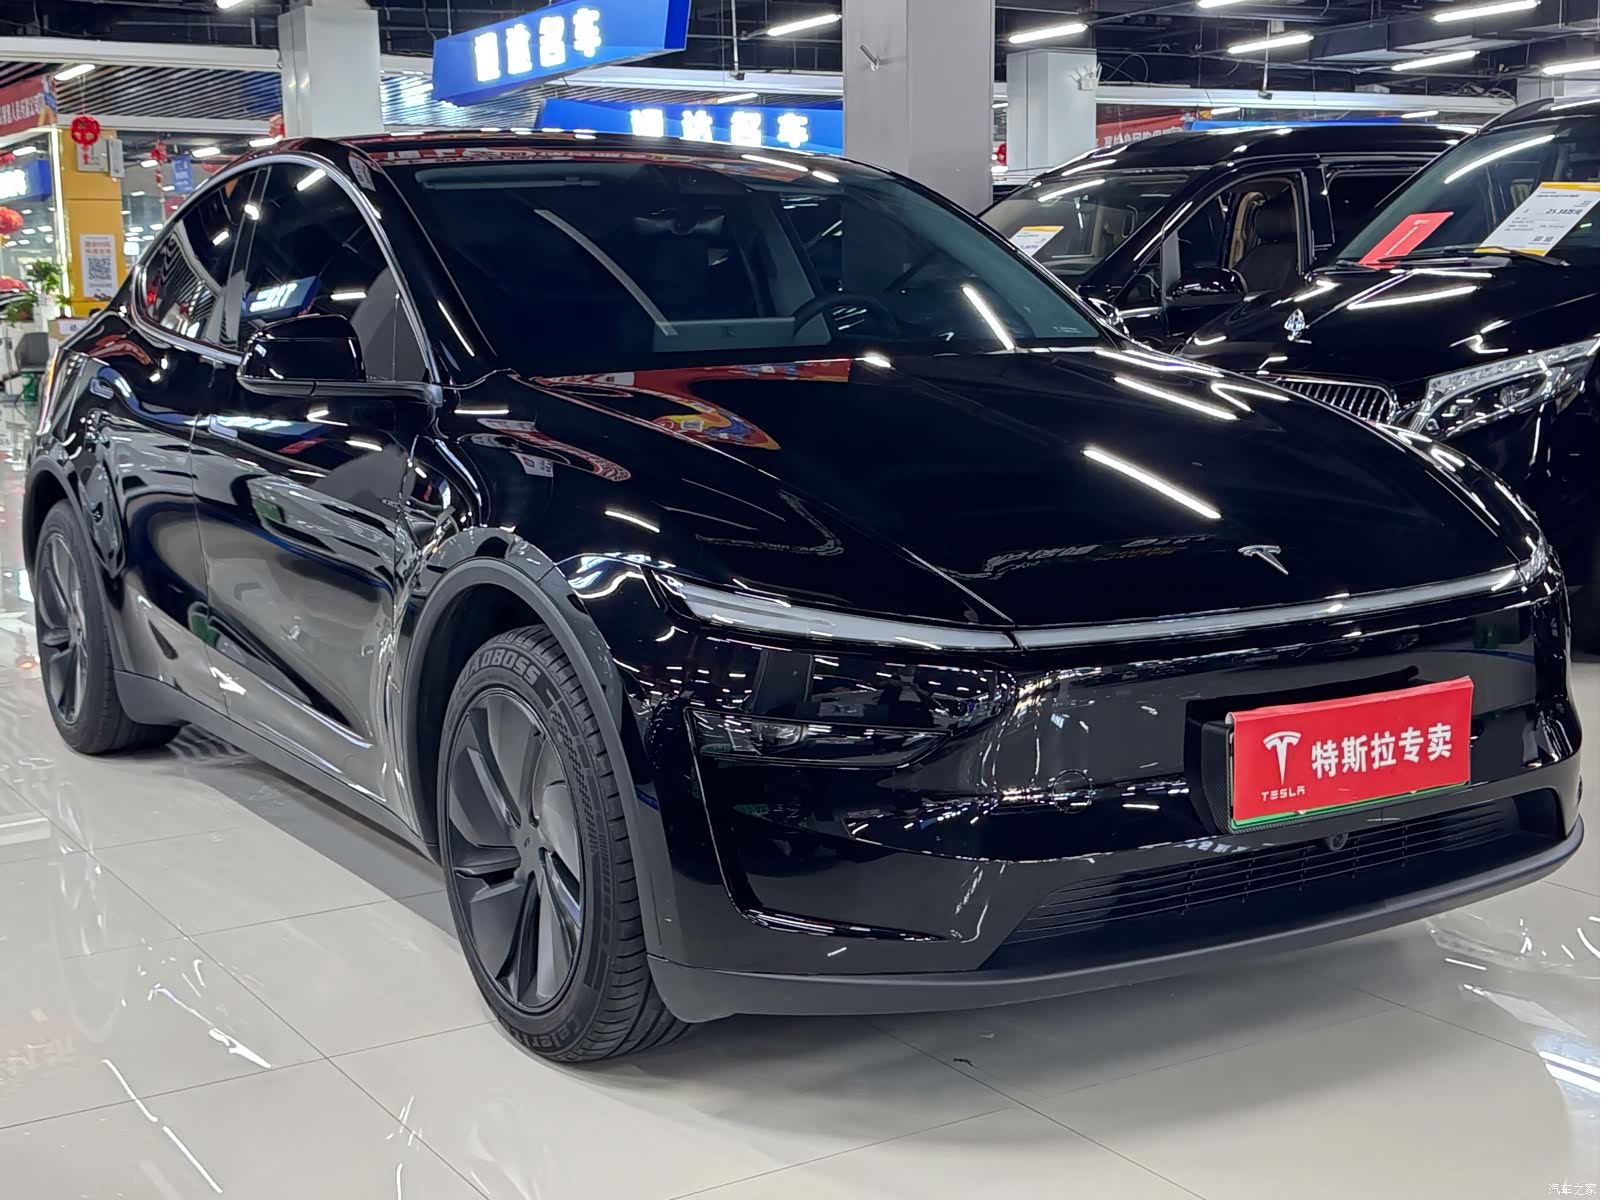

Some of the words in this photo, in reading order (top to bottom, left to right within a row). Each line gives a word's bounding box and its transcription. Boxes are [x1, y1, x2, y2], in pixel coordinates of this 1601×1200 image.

[1311, 722, 1452, 779] 特斯拉专卖
[1261, 785, 1305, 801] TESLA
